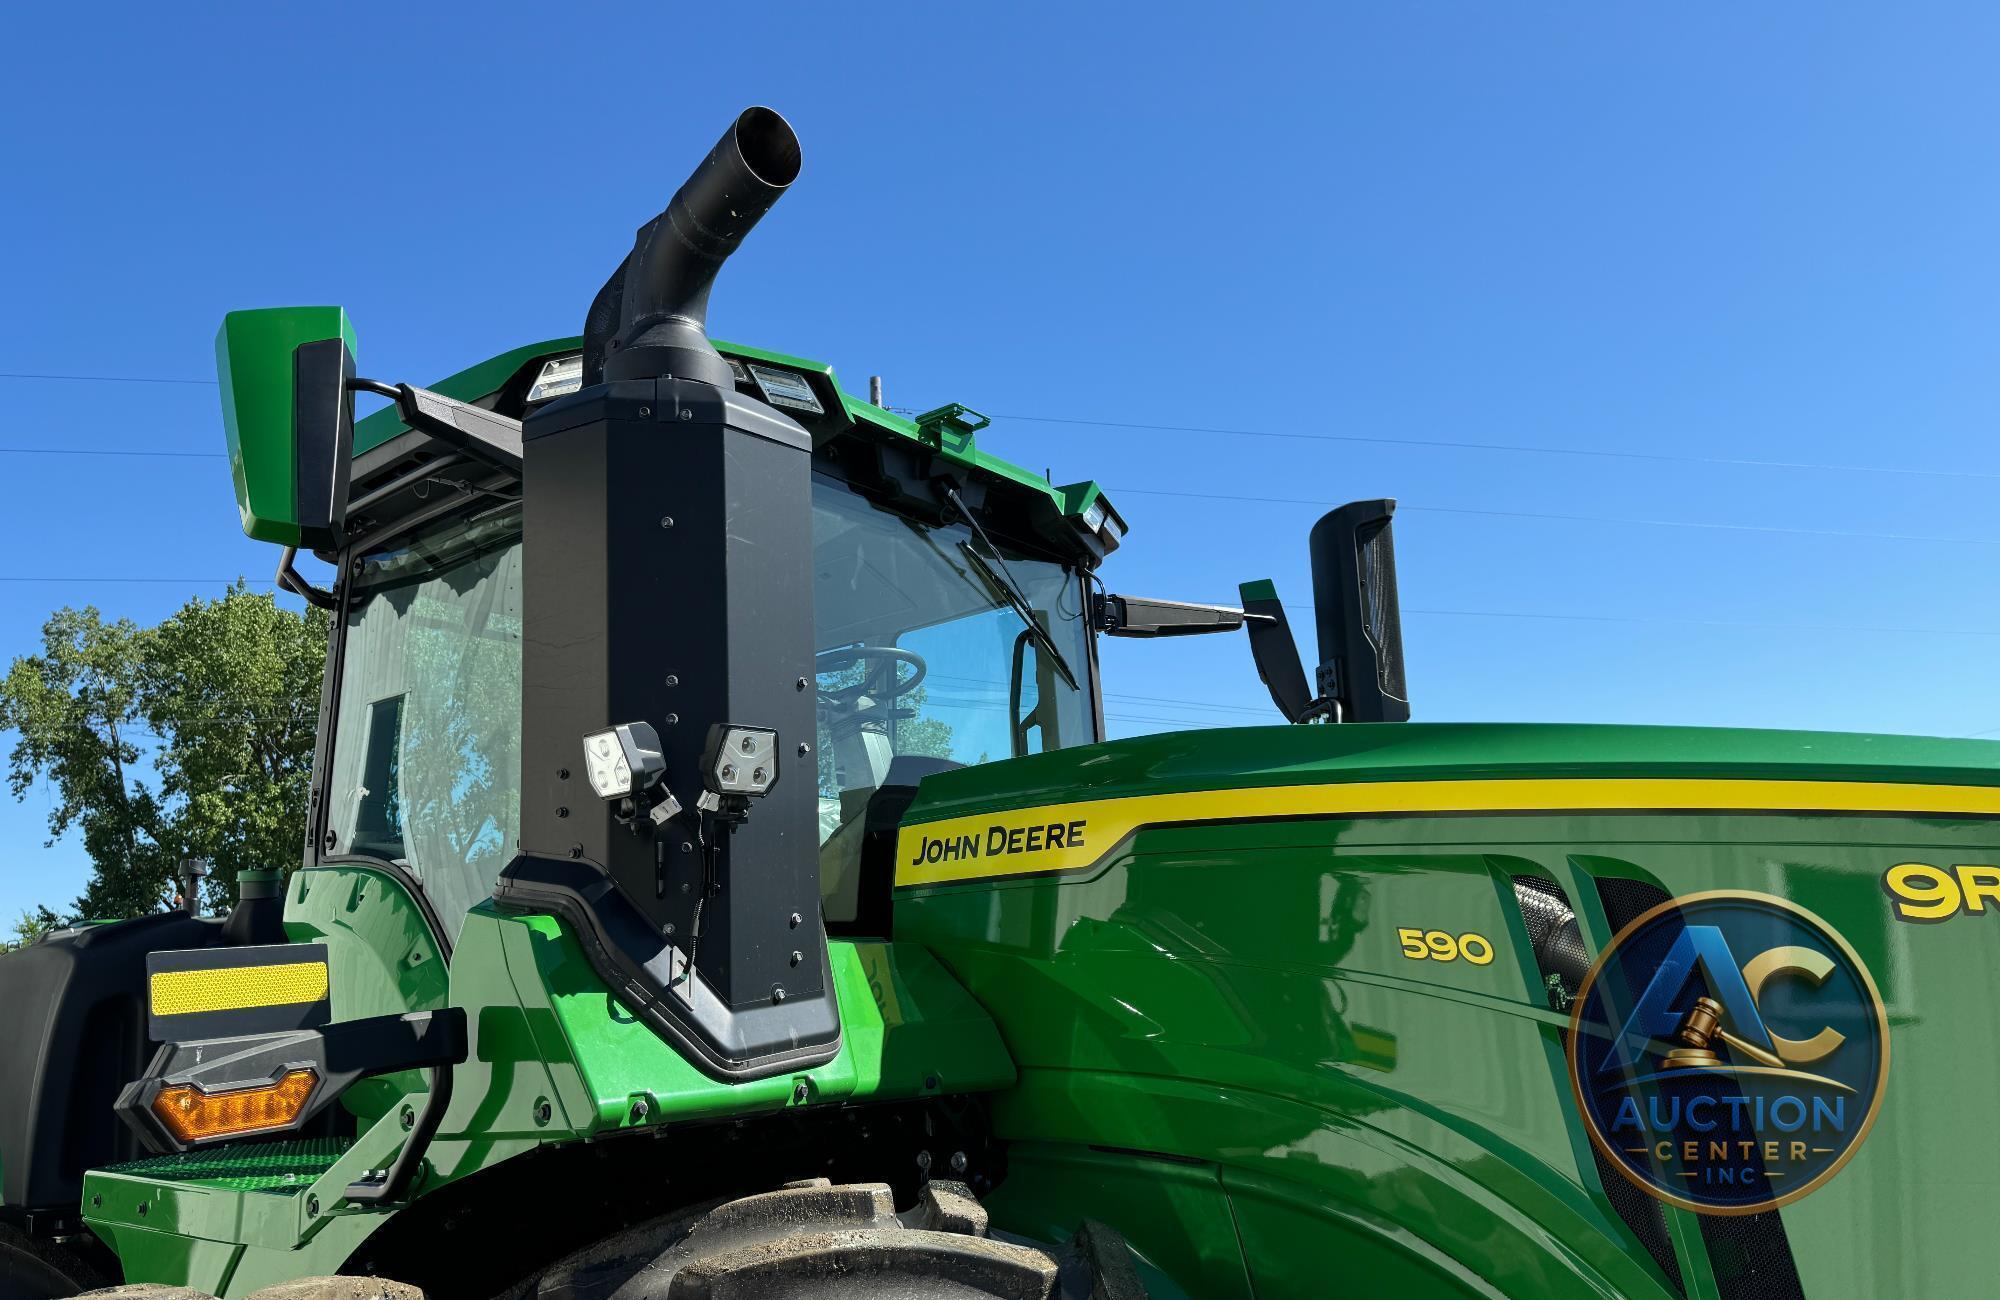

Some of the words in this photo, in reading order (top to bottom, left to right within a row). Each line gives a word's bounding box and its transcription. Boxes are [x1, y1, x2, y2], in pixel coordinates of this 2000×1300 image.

[912, 834, 981, 866] JOHN
[985, 820, 1087, 857] DEERE
[1397, 927, 1495, 966] 590
